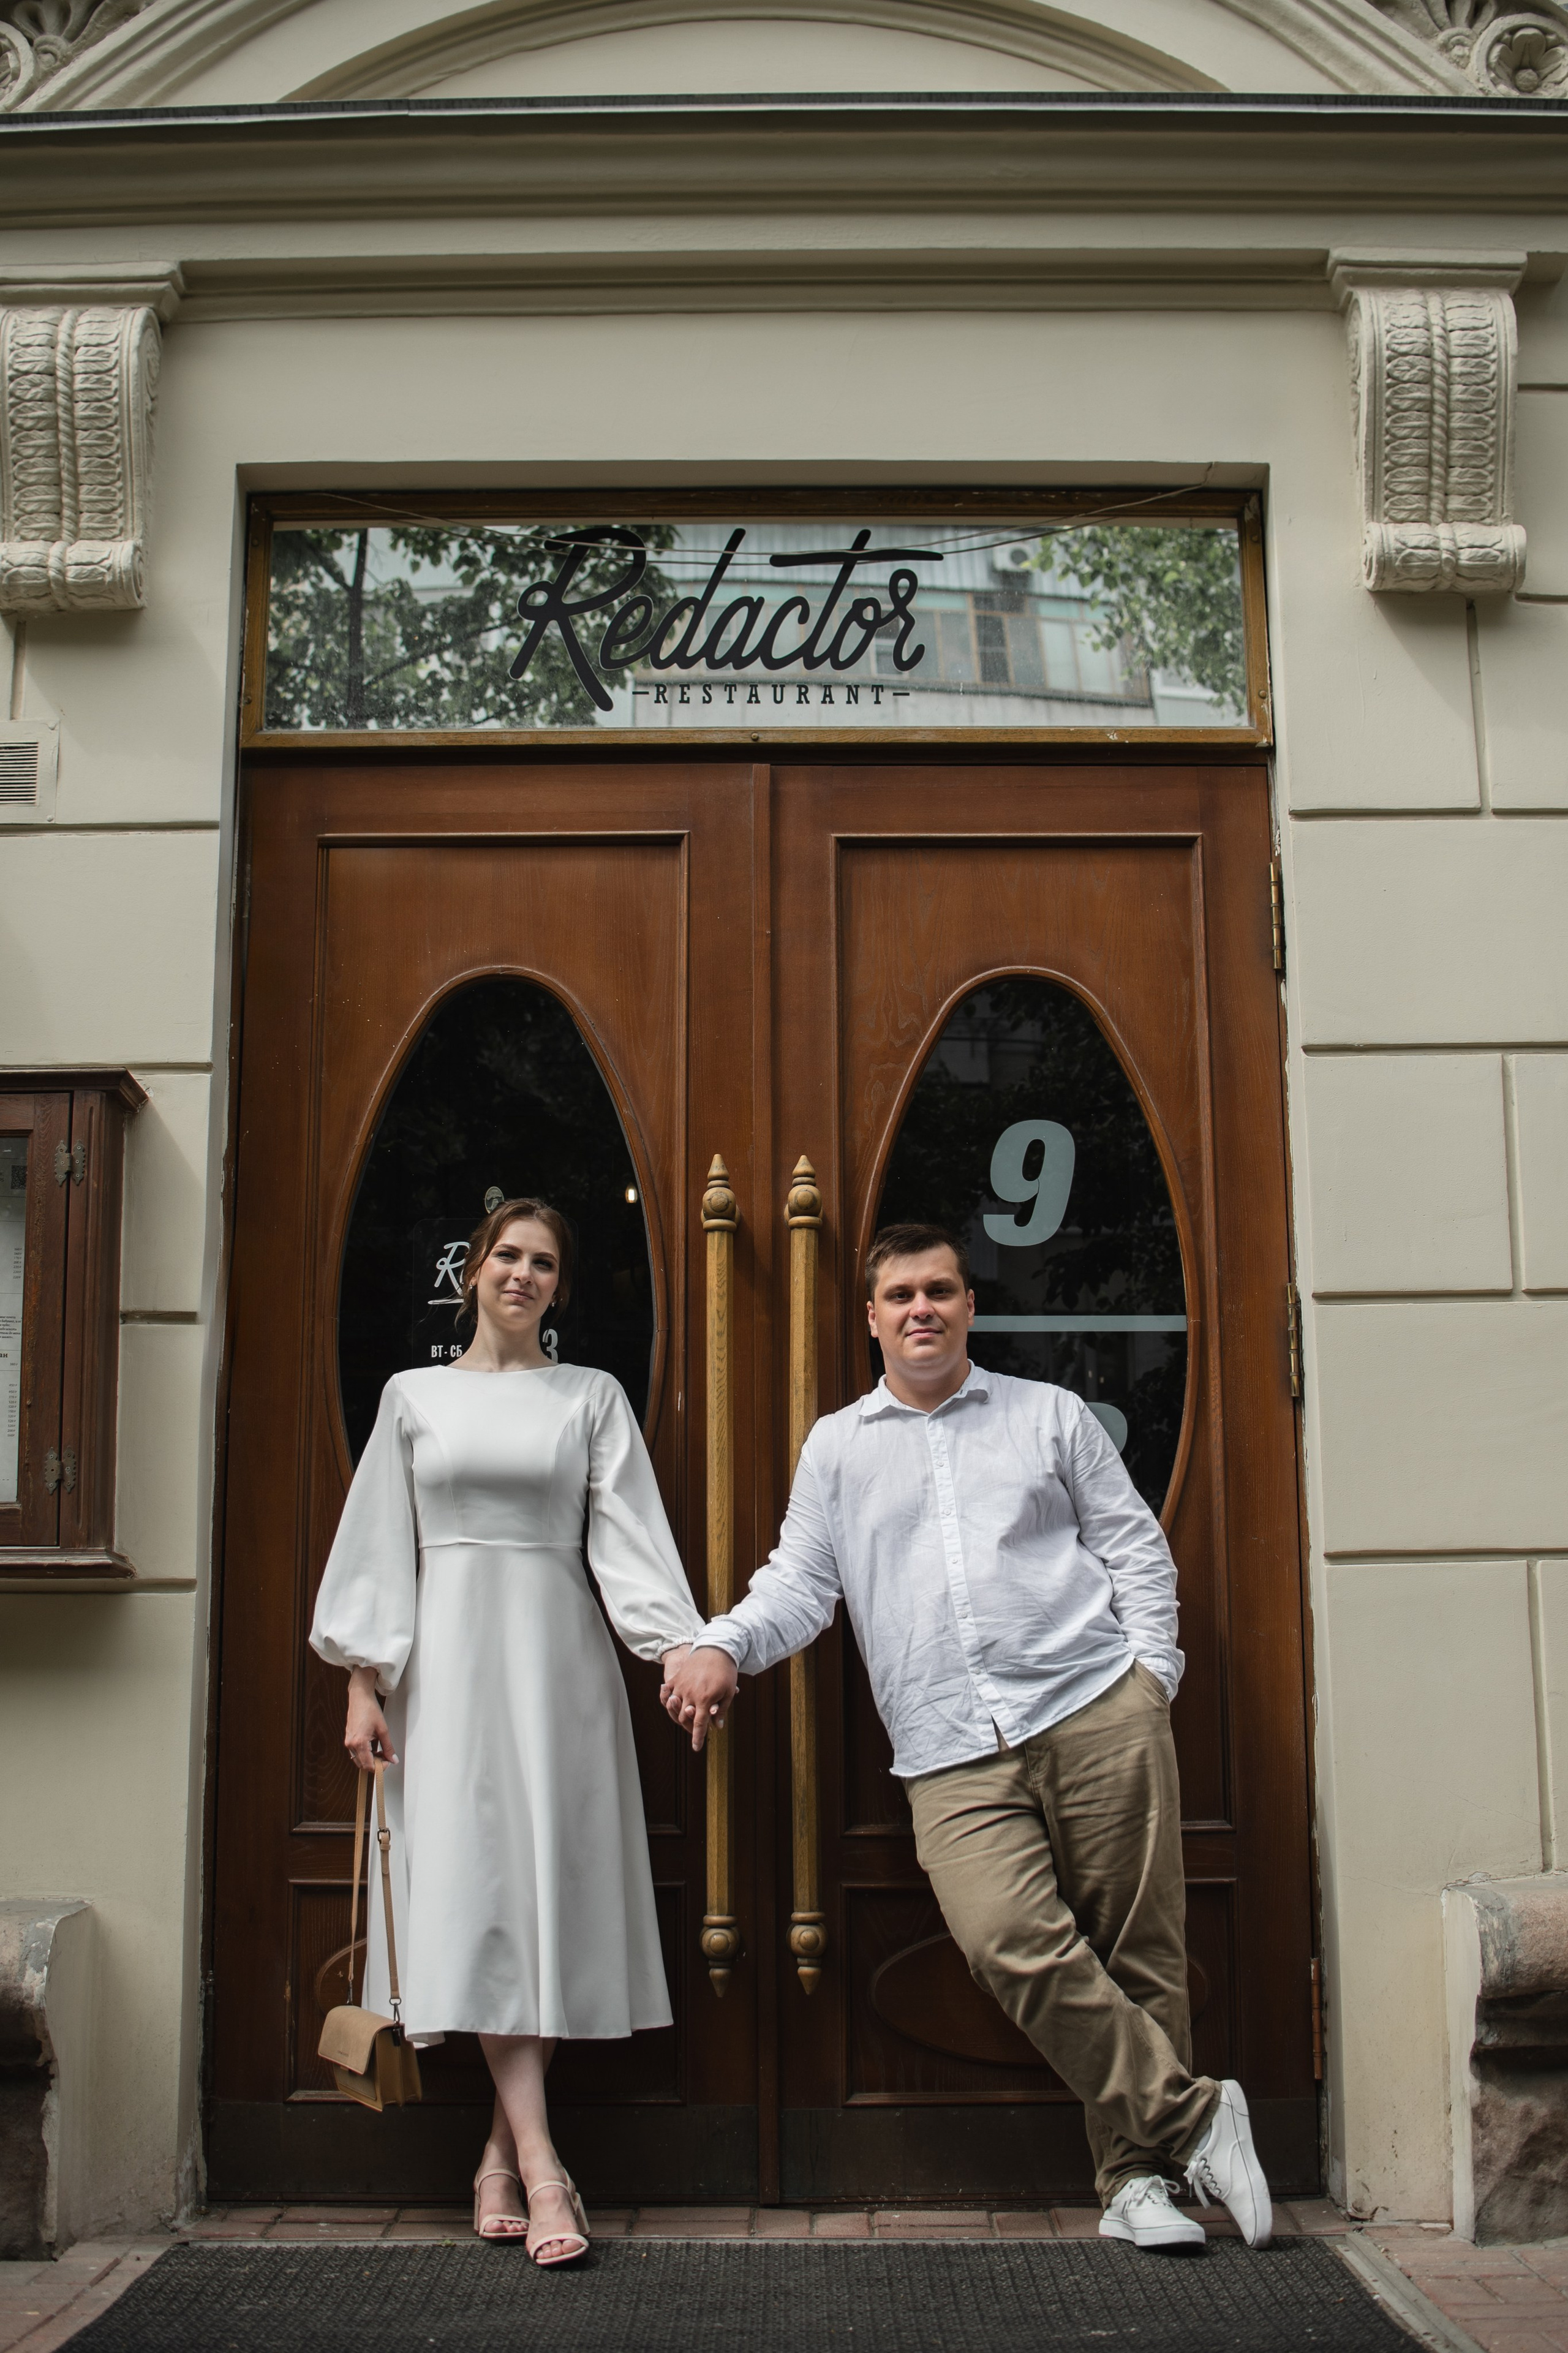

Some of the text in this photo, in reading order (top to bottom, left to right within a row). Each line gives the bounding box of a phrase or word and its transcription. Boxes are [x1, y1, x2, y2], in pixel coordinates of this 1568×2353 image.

[509, 528, 944, 712] Redactor
[654, 683, 885, 705] RESTAURANT
[983, 1120, 1076, 1247] 9
[450, 1345, 462, 1357] СБ
